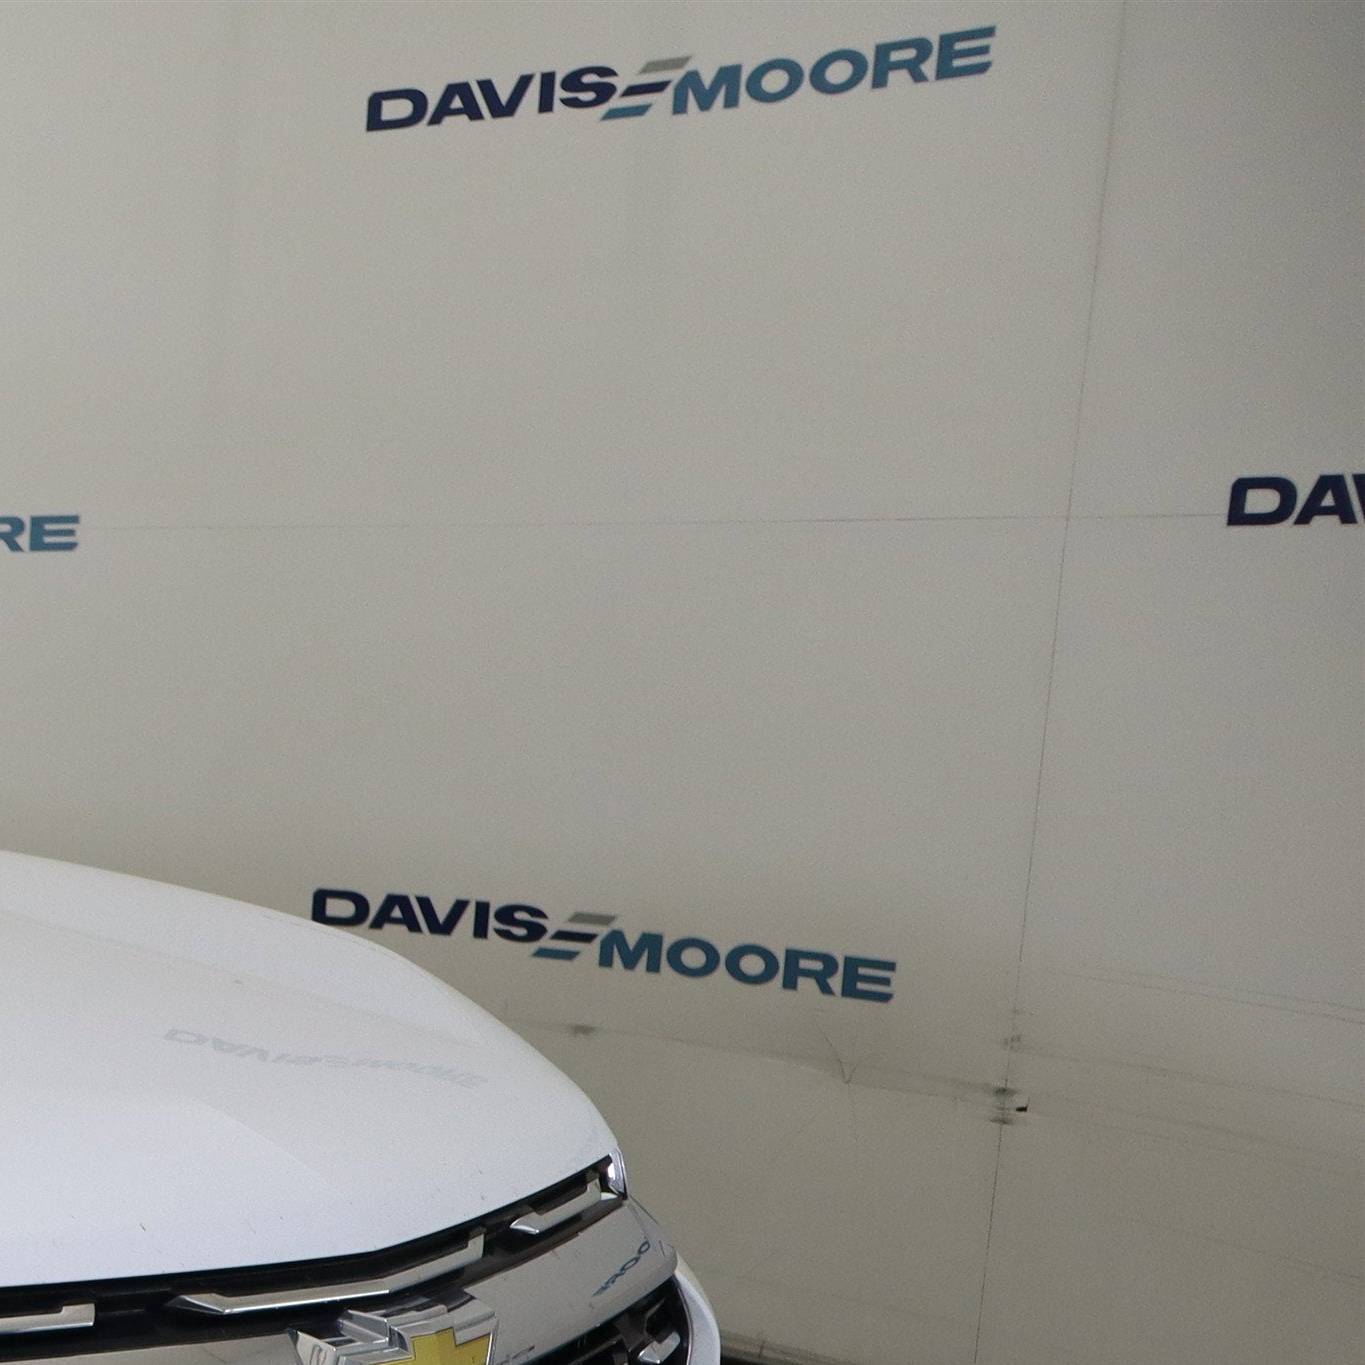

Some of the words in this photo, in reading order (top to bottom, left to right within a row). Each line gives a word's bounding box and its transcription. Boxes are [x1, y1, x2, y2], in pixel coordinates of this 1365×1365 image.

[366, 65, 620, 132] DAVIS
[671, 25, 997, 116] MOORE
[311, 888, 549, 943] DAVIS
[597, 929, 897, 1003] MOORE
